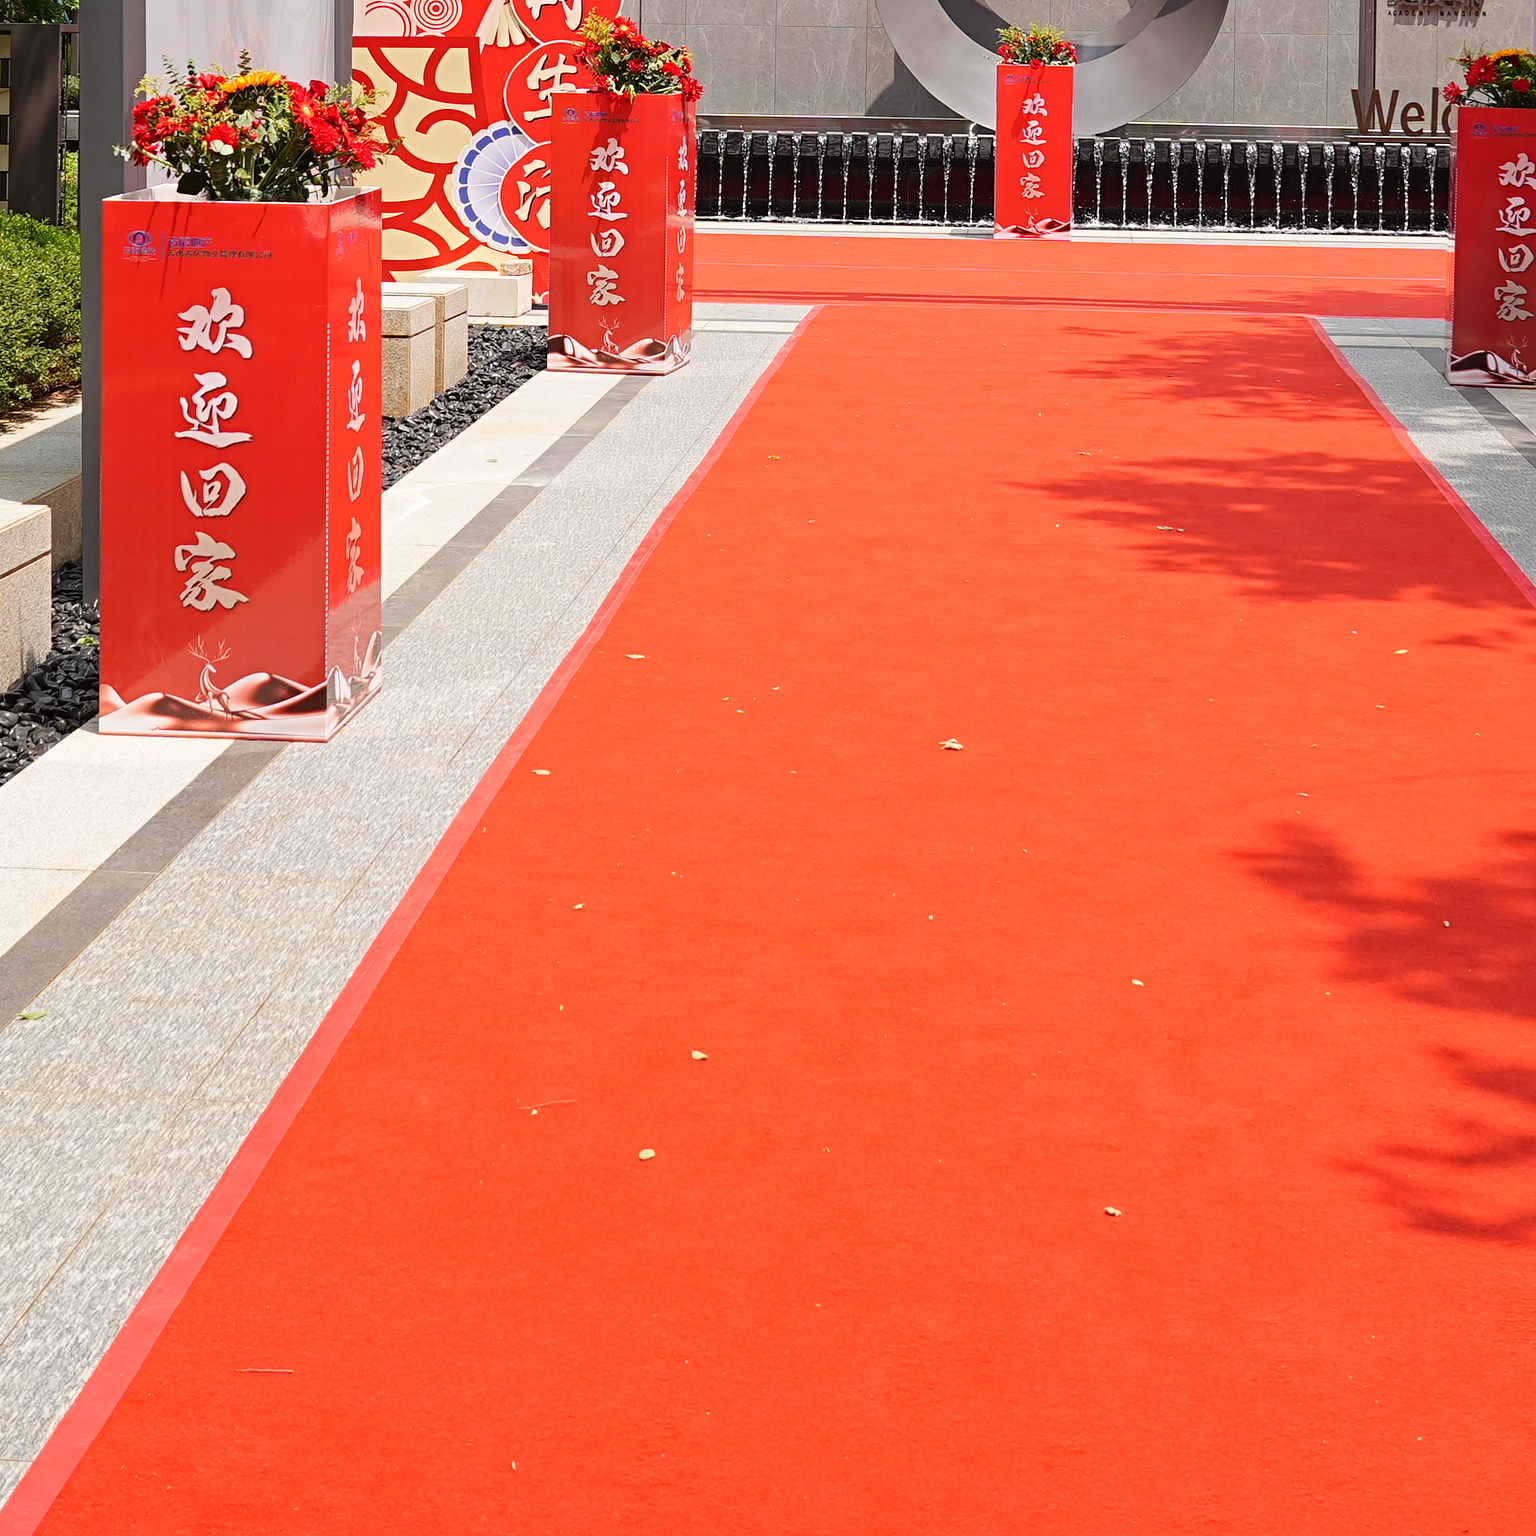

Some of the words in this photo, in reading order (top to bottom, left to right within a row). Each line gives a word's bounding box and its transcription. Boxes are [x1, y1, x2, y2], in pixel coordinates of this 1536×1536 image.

[586, 137, 630, 307] 欢迎回家
[677, 136, 688, 302] 欢迎回家
[1020, 93, 1048, 199] 欢迎回家
[174, 287, 253, 612] 欢迎回家
[347, 276, 366, 593] 欢迎回家
